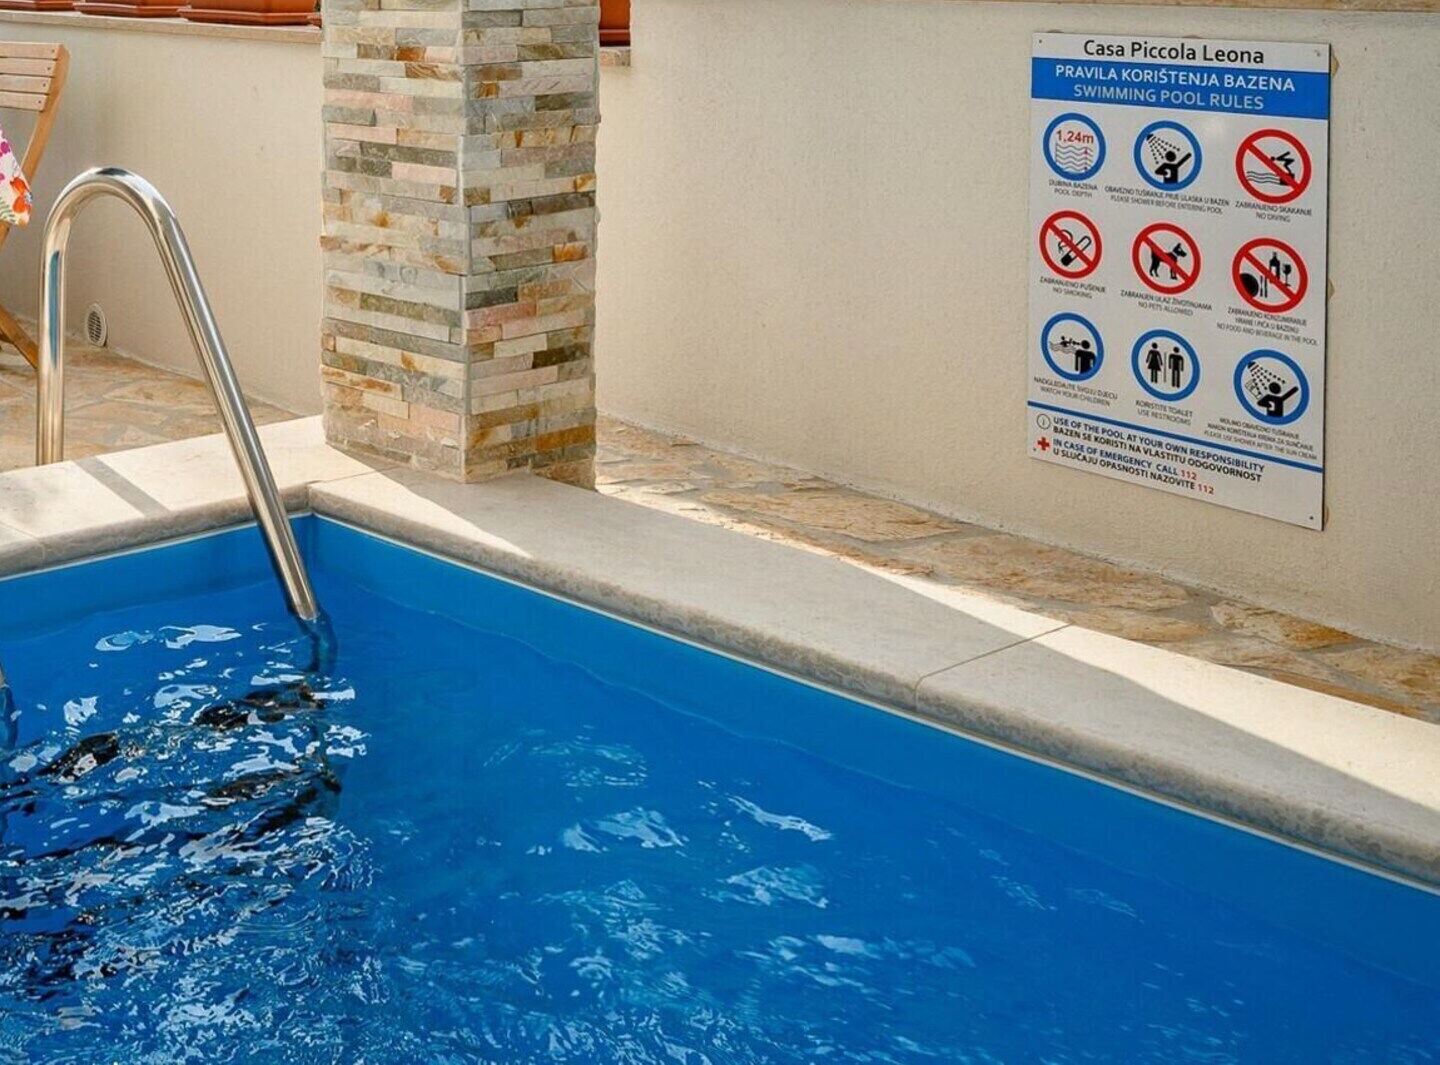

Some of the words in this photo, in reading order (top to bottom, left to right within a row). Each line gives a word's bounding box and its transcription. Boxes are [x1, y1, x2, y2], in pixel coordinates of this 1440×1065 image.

[1084, 40, 1125, 57] Casa
[1131, 42, 1196, 60] Piccola
[1202, 45, 1264, 64] Leona
[1055, 65, 1117, 81] PRAVILA
[1122, 67, 1219, 88] KORIŠTENJA
[1225, 74, 1295, 92] BAZENA
[1074, 85, 1156, 103] SWIMMING
[1161, 90, 1205, 107] POOL
[1211, 94, 1264, 110] RULES
[1056, 129, 1094, 145] 1.24m
[1053, 416, 1069, 426] USE
[1070, 420, 1082, 429] OF
[1084, 423, 1099, 434] THE
[1101, 426, 1125, 440] POOL
[1126, 433, 1138, 442] AT
[1139, 435, 1163, 448] YOUR
[1165, 442, 1187, 455] OWN
[1190, 448, 1265, 472] RESPONSIBILITY
[1053, 426, 1080, 438] BAZEN
[1082, 432, 1092, 441] SE
[1094, 436, 1127, 450] KORISTI
[1129, 444, 1141, 454] NA
[1143, 447, 1186, 464] VLASTITU
[1187, 458, 1262, 482] ODGOVORNOST
[1053, 438, 1062, 447] IN
[1064, 441, 1084, 453] CASE
[1086, 447, 1098, 455] OF
[1100, 449, 1152, 469] EMERGENCY
[1156, 464, 1178, 476] CALL
[1181, 469, 1197, 481] 112
[1099, 459, 1148, 478] OPASNOSTI
[1150, 472, 1195, 489] NAZOVITE
[1197, 483, 1214, 495] 112
